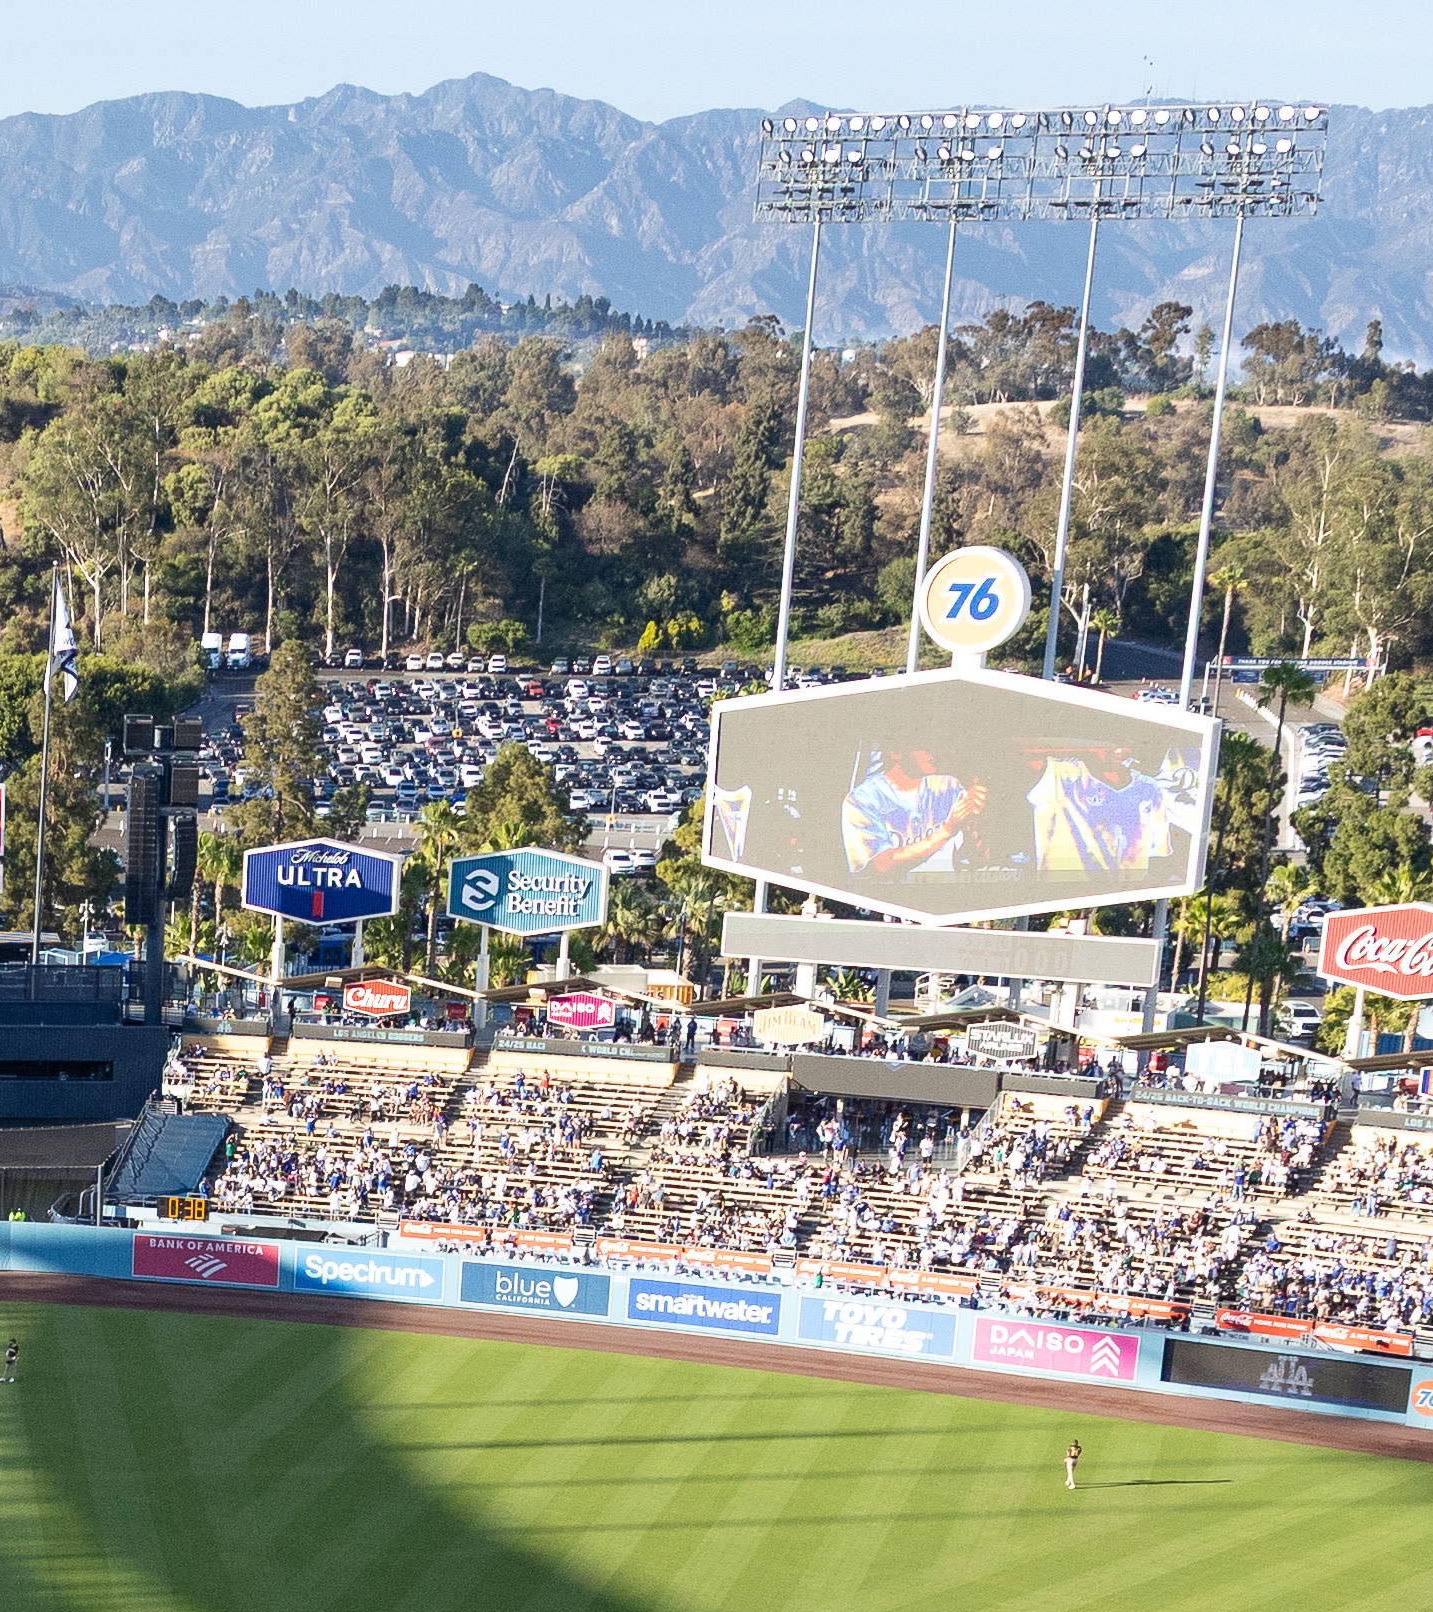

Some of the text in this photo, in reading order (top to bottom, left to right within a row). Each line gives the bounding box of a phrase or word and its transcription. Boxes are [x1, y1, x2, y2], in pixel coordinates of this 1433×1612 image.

[945, 578, 1001, 621] 76
[291, 848, 351, 865] Michelob
[277, 866, 362, 889] ULTRA
[507, 870, 592, 895] Security
[507, 893, 582, 917] Benefit
[346, 987, 408, 1010] Churu
[969, 1027, 1035, 1045] STARLUX
[168, 1198, 205, 1220] 0:38
[149, 1238, 263, 1256] BANK OF AMERICA
[306, 1254, 422, 1286] Spectrum
[495, 1271, 550, 1297] blue
[496, 1294, 551, 1306] CALIFORNIA
[635, 1290, 771, 1324] smartwater
[822, 1301, 908, 1327] TOYO
[834, 1324, 931, 1352] TIRES
[990, 1325, 1084, 1354] DAISO
[990, 1345, 1034, 1359] JAPAN
